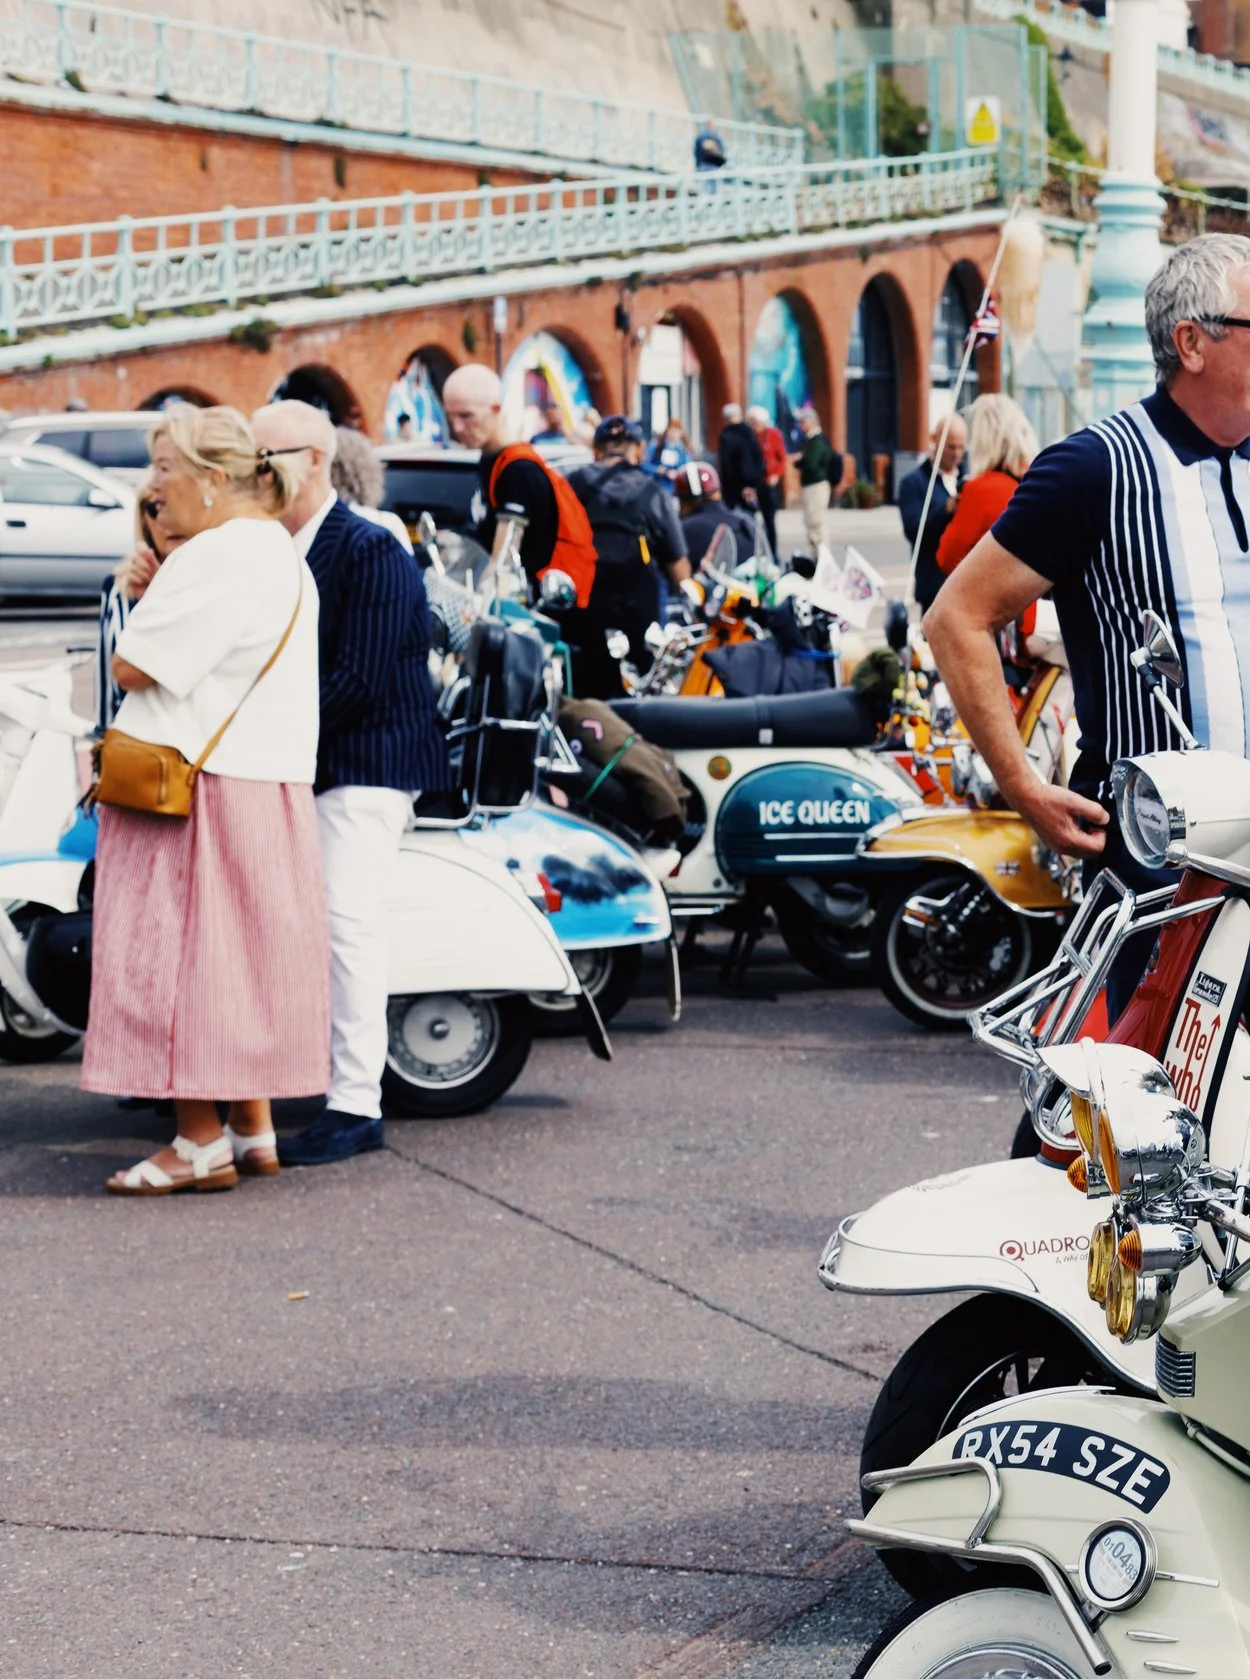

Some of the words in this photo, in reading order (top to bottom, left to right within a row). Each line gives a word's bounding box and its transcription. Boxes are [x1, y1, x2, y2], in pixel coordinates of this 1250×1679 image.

[759, 800, 796, 825] ICE
[797, 800, 870, 825] QUEEN
[1175, 997, 1208, 1061] The
[960, 1424, 1062, 1468] RX54
[1072, 1436, 1165, 1505] SZE
